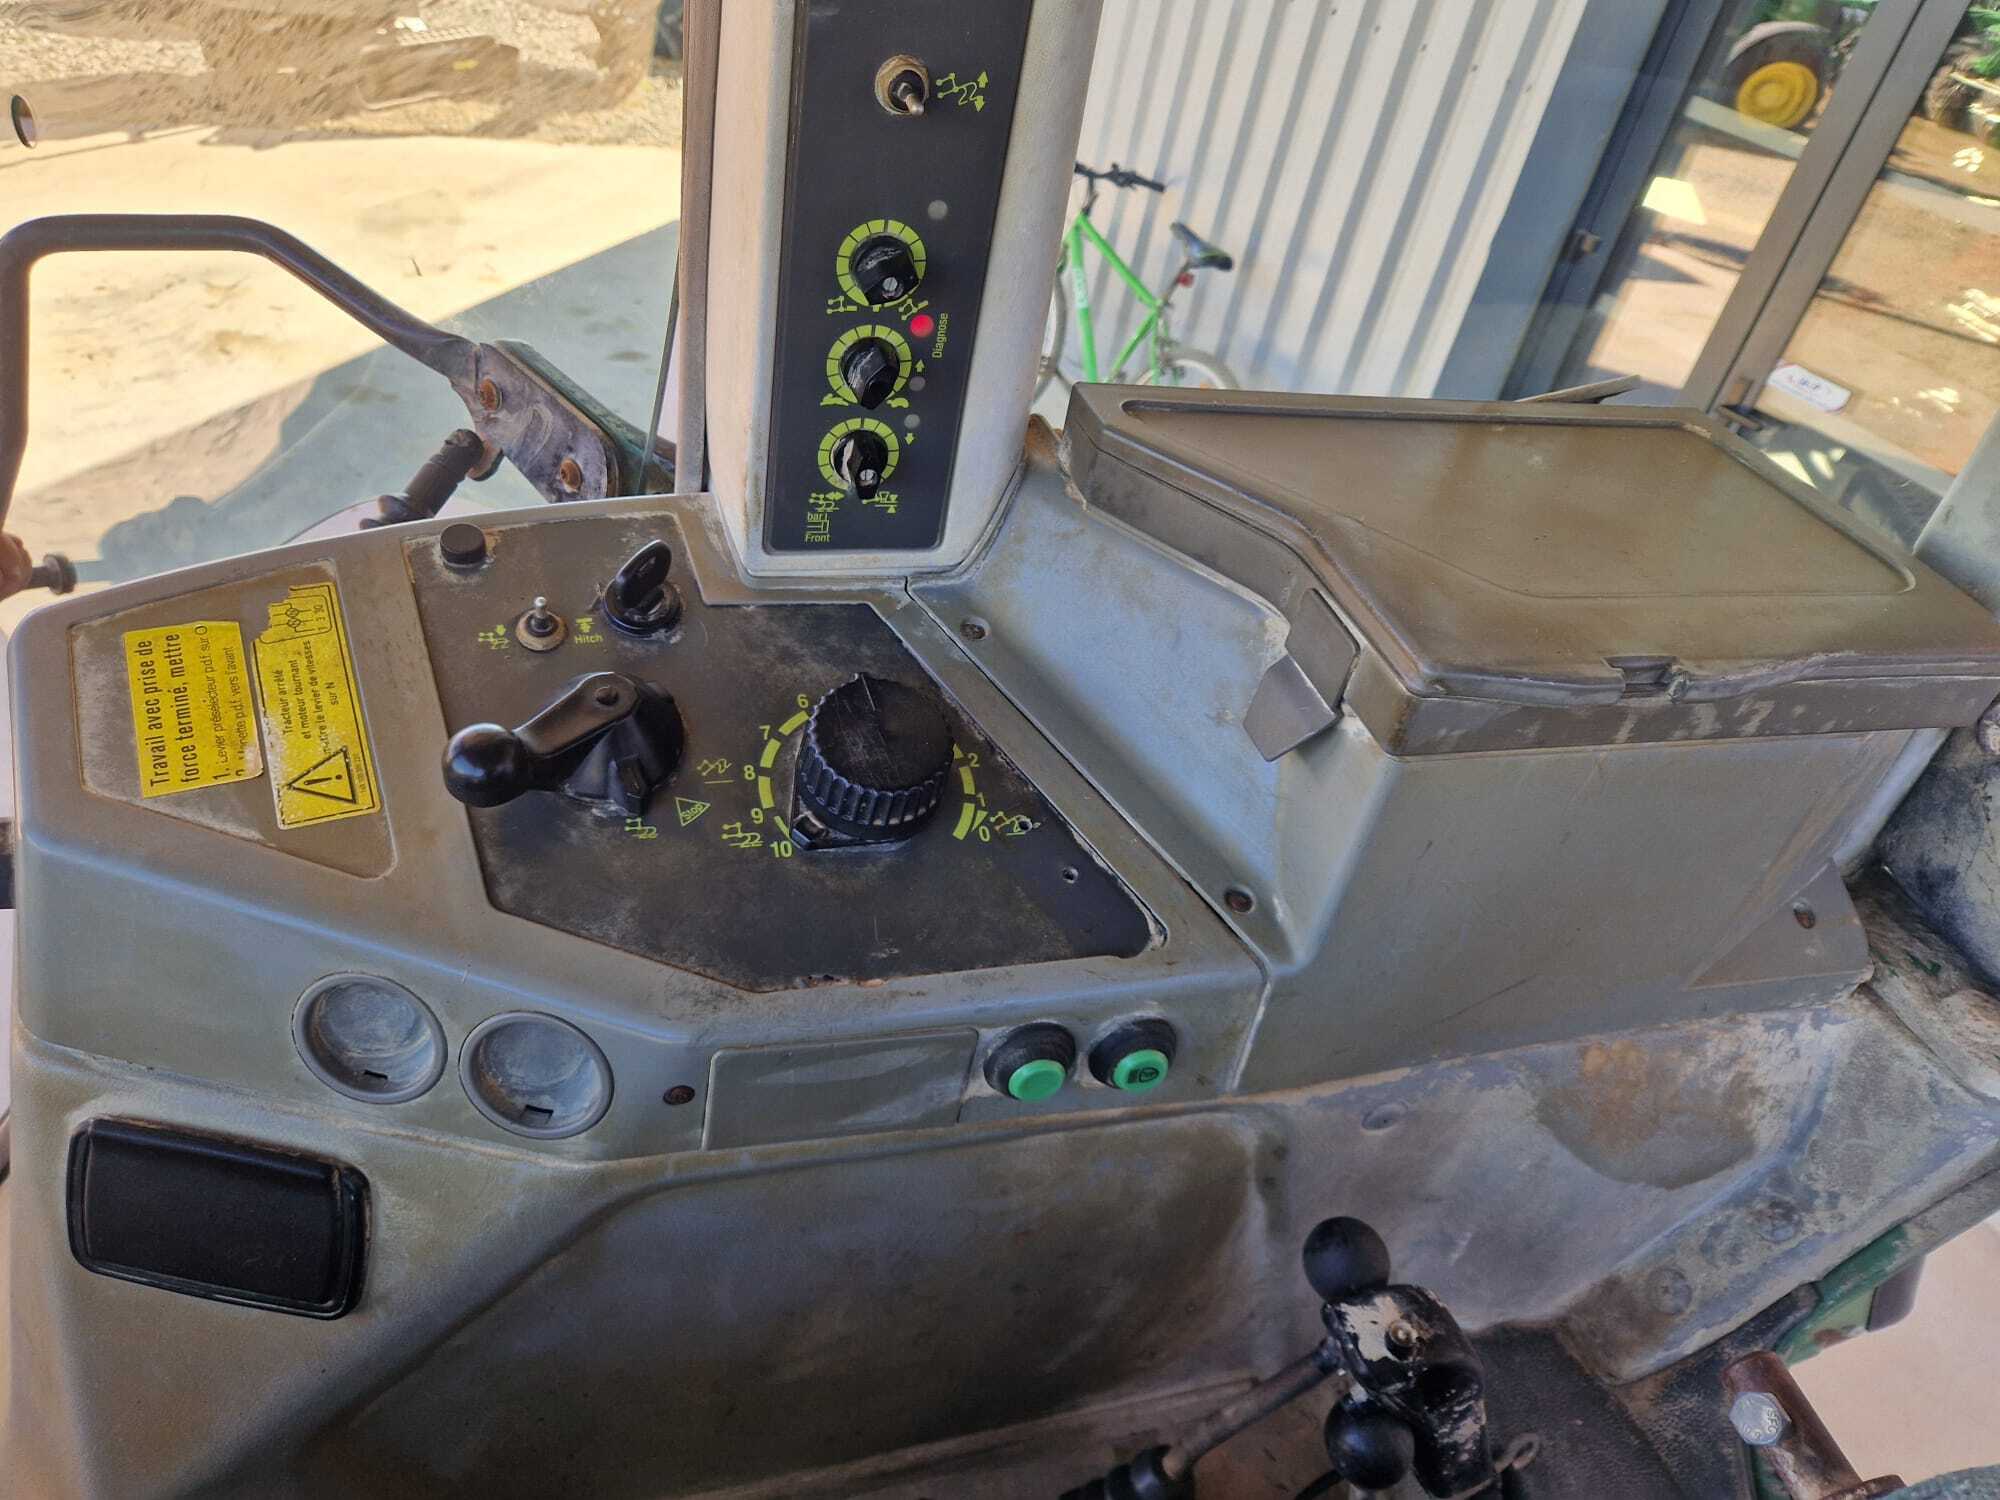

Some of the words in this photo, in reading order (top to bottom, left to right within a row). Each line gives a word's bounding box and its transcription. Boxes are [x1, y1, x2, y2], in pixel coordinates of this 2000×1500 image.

[931, 313, 949, 359] Diagnose
[805, 533, 831, 543] Front
[199, 637, 211, 652] sur
[574, 633, 604, 645] Hitch
[134, 640, 153, 656] de
[163, 633, 185, 678] mettre
[303, 640, 317, 674] vitesses
[138, 660, 159, 694] prise
[289, 660, 304, 696] tournant
[307, 676, 318, 687] de
[326, 681, 336, 689] N
[229, 677, 240, 697] vers
[311, 689, 325, 713] levier
[329, 690, 340, 706] sur
[796, 693, 809, 708] 6
[144, 697, 162, 731] avec
[167, 682, 195, 741] terminé,
[279, 697, 293, 735] Tracteur
[297, 698, 311, 729] moteur
[759, 725, 771, 740] 7
[144, 735, 170, 787] Travail
[180, 744, 201, 783] force
[967, 753, 980, 768] 2
[212, 767, 231, 781] 1.
[743, 765, 756, 780] 8
[976, 792, 986, 807] 1
[751, 808, 764, 824] 9
[978, 826, 990, 842] 0
[770, 841, 793, 858] 10
